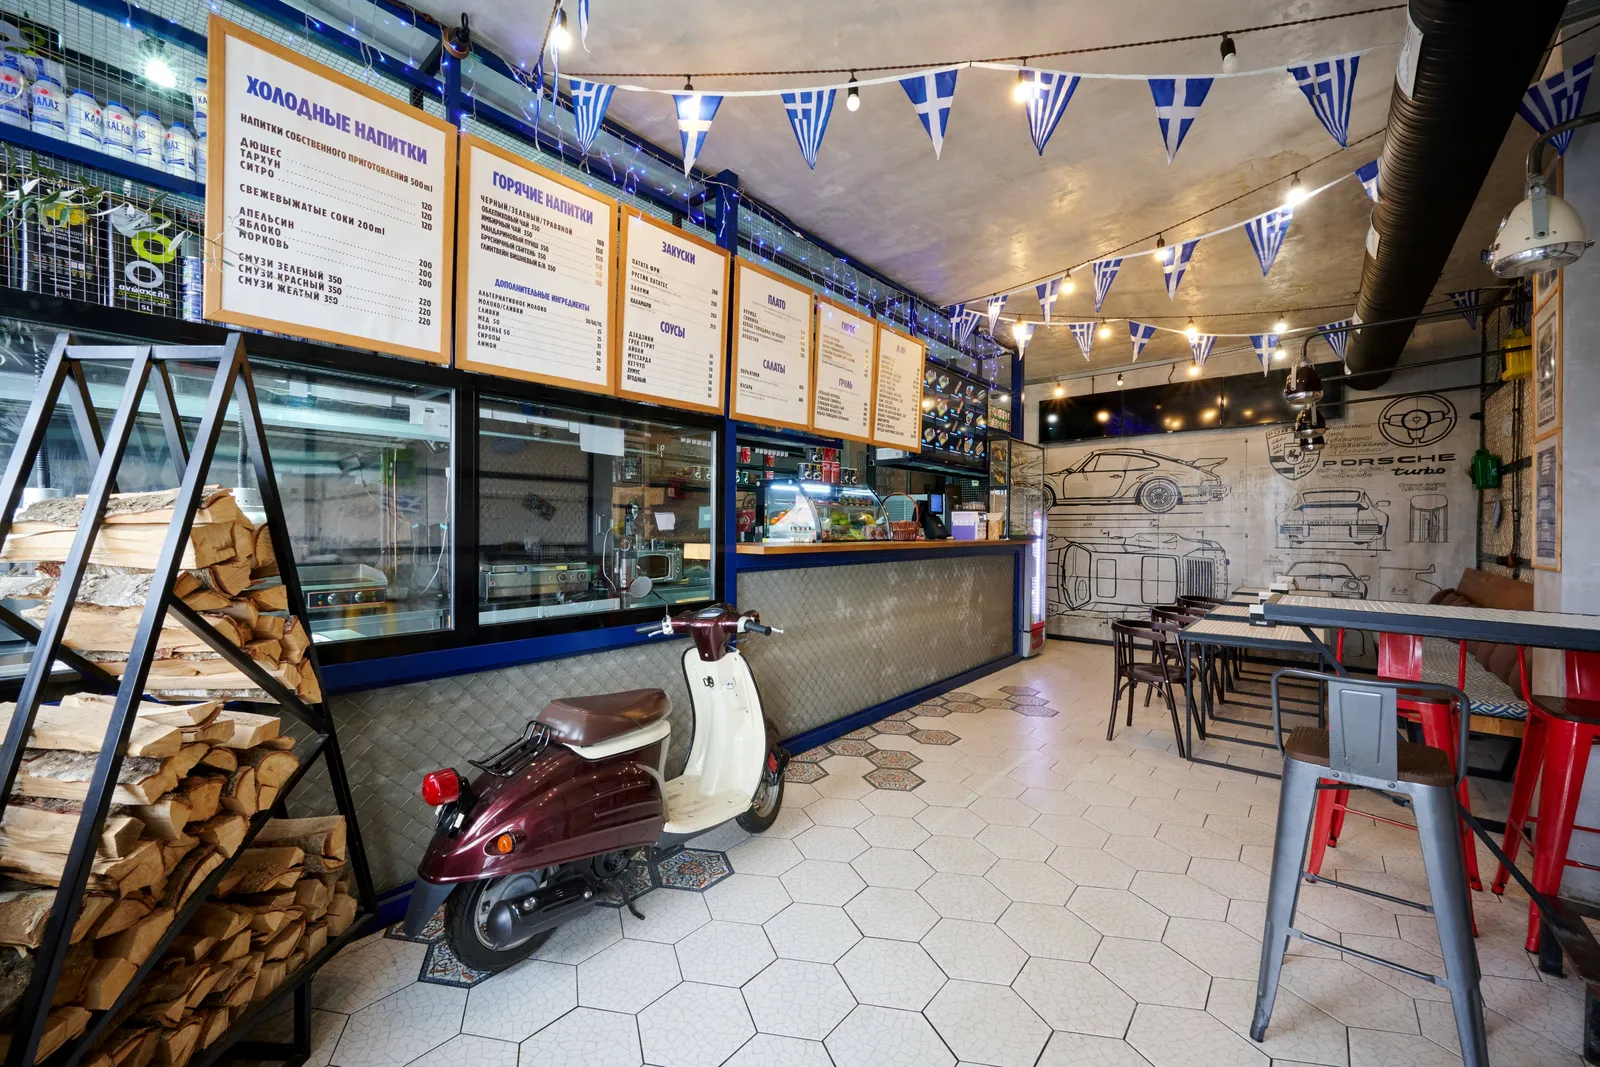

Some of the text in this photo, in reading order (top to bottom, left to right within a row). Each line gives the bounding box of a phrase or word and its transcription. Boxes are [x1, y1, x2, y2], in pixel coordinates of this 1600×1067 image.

[246, 74, 427, 165] ХОЛОДНЫЕ НАПИТКИ
[240, 112, 433, 193] НАПИТКИ СОБСТВЕННОГО ПРИГОТОВЛЕНИЯ 500ml
[240, 136, 433, 212] ДЮШЕС 120
[240, 148, 432, 222] ТАРХУН 120
[240, 160, 432, 231] СИТРО 120
[493, 170, 593, 225] ГОРЯЧИЕ НАПИТКИ
[240, 182, 385, 236] СВЕЖЕВЫЖАТЫЕ СОКИ 200ml
[481, 204, 519, 225] ОБЛЕПИХОВЫЙ
[519, 219, 529, 229] ЧАЙ
[481, 213, 510, 230] ИМБИРНЫЙ
[511, 224, 521, 234] ЧАЙ
[239, 206, 432, 270] АПЕЛЬСИН 200
[481, 223, 523, 244] МАНДАРИНОВЫЙ
[524, 238, 538, 249] ПУНШ
[481, 232, 515, 250] БРУСНИЧНЫЙ
[515, 244, 536, 257] СБИТЕНЬ
[239, 217, 432, 279] ЯБЛОКО 200
[480, 242, 509, 258] ГЛИНТВЕЙН
[510, 251, 537, 267] ВИШНЕВЫЙ
[662, 241, 696, 265] ЗАКУСКИ
[239, 229, 432, 288] МОРКОВЬ 200
[632, 258, 649, 270] ПАТАТА
[650, 265, 660, 274] ФРИ
[239, 251, 431, 307] СМУЗИ ЗЕЛЕНЫЙ 350 220
[631, 271, 649, 282] РУСТИК
[650, 277, 668, 289] ПАТАТЕС
[239, 263, 431, 317] СМУЗИ КРАСНЫЙ 350 220
[494, 278, 590, 313] ДОПОЛНИТЕЛЬНЫЕ ИНГРЕДИЕНТЫ
[631, 284, 650, 295] ХАЛУМИ
[238, 274, 273, 291] СМУЗИ
[277, 283, 320, 301] ЖЕЛТЫЙ
[418, 317, 431, 326] 220
[478, 289, 525, 307] АЛЬТЕРНАТИВНОЕ
[527, 302, 547, 313] МОЛОКО
[478, 298, 523, 315] МОЛОКО/СЛИВКИ
[630, 297, 652, 309] КАЛАМАРИ
[768, 294, 786, 310] ПЛАТО
[478, 306, 500, 317] СЛИВКИ
[478, 315, 489, 323] МЕД
[477, 332, 501, 342] СИРОПЫ
[478, 323, 502, 334] ВАРЕНЬЕ
[629, 331, 654, 343] ДЗАДЗИКИ
[660, 320, 685, 339] СОУСЫ
[477, 340, 497, 350] ЛИМОН
[628, 338, 640, 346] ГРЕК
[640, 341, 655, 350] СТРИТ
[628, 345, 644, 354] АЙОЛИ
[627, 360, 645, 369] КЕТЧУП
[628, 353, 652, 364] МУСТАРДА
[763, 359, 786, 374] САЛАТЫ
[627, 367, 641, 375] ХУМУС
[627, 374, 646, 384] ЯГОДНЫЙ
[838, 378, 853, 390] ГРИЛЬ
[1322, 453, 1456, 469] PORSCHE
[1391, 467, 1447, 477] turbo
